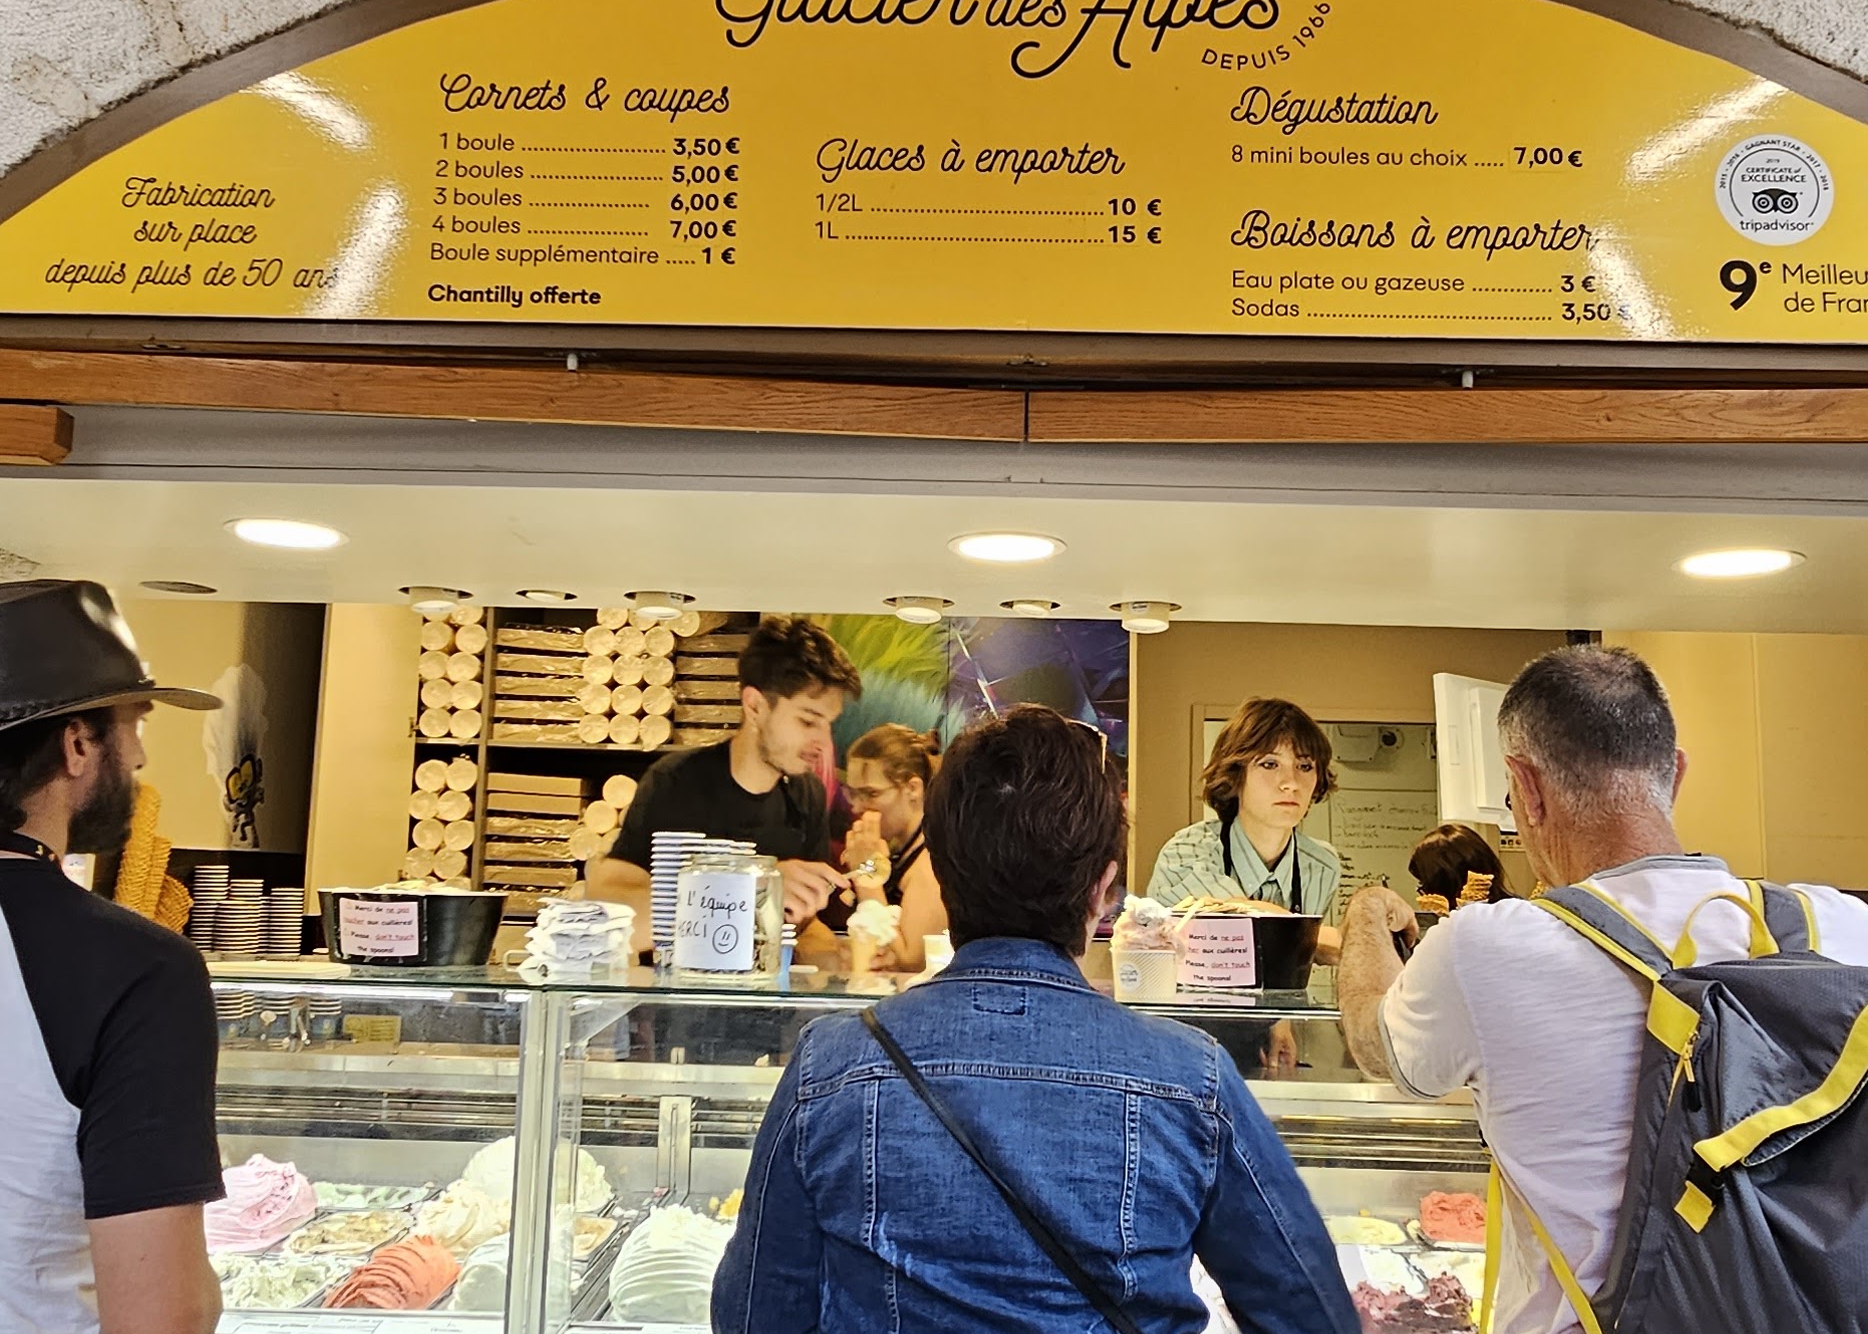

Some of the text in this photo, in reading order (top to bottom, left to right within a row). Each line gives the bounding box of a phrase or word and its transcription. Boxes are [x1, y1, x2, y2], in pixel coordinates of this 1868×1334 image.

[1201, 2, 1331, 71] DEPUIS 1966
[439, 73, 730, 124] Cornets & coupes
[1230, 85, 1439, 136] Dégustation
[439, 132, 448, 150] 1
[456, 132, 515, 152] boule
[816, 137, 1126, 185] Glaces à emporter
[1231, 144, 1243, 163] 8
[1250, 146, 1293, 164] mini
[1299, 145, 1370, 165] boules
[1376, 152, 1403, 166] au
[1409, 148, 1468, 167] choix
[435, 159, 449, 178] 2
[455, 160, 524, 179] boules
[1741, 174, 1807, 183] EXCELLENCE
[1745, 166, 1792, 174] CERTIFICATE
[121, 176, 276, 208] Fabrication
[433, 186, 447, 205] 3
[453, 187, 522, 207] boules
[815, 192, 863, 213] 1/2L
[1107, 197, 1137, 216] 10
[133, 217, 258, 252] sur place
[431, 214, 445, 233] 4
[451, 215, 521, 234] boules
[814, 220, 839, 240] 1L
[1108, 225, 1136, 244] 15
[1230, 209, 1600, 262] Boissons à emporter
[1739, 219, 1810, 233] tripadvisor
[430, 242, 490, 262] Boule
[495, 244, 660, 267] supplémentaire
[701, 246, 712, 265] 1
[45, 258, 127, 293] depuis
[131, 259, 192, 294] plus
[203, 261, 237, 287] de
[242, 258, 284, 287] 50
[1232, 269, 1273, 289] Eau
[1279, 270, 1335, 294] plate
[1341, 276, 1368, 290] ou
[1374, 277, 1465, 296] gazeuse
[1560, 275, 1575, 293] 3
[1782, 263, 1868, 286] Meilleu
[427, 283, 602, 309] Chantilly offerte
[1231, 297, 1300, 318] Sodas
[1783, 291, 1815, 313] de
